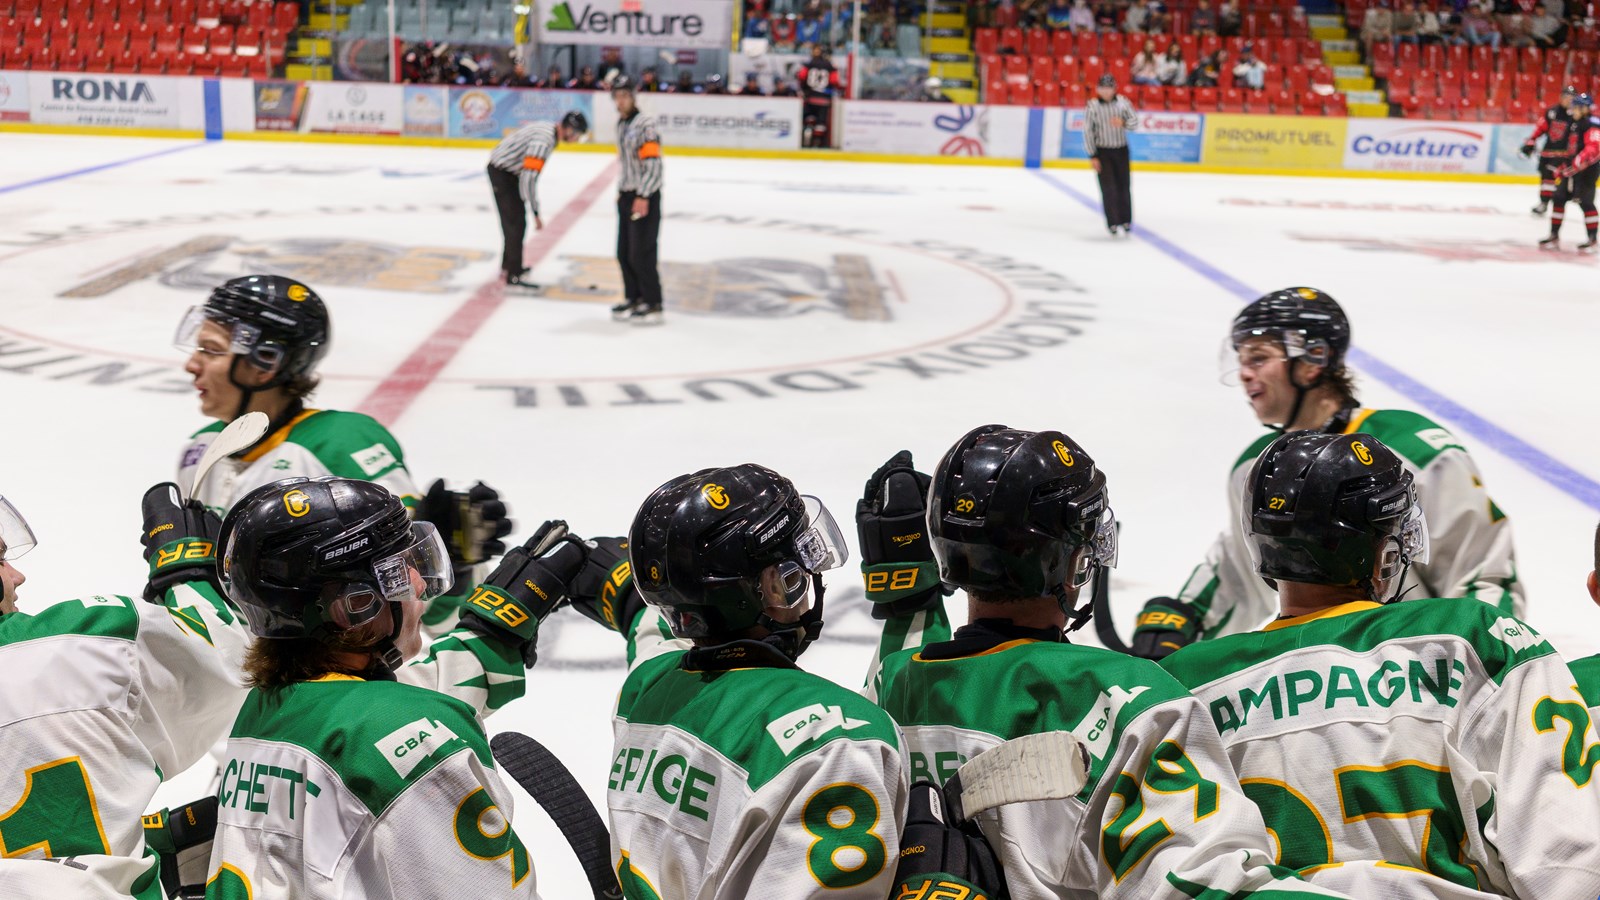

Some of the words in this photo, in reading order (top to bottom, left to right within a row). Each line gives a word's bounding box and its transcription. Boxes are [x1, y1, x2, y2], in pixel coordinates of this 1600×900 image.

[560, 2, 703, 36] Venture
[52, 78, 154, 102] RONA
[1215, 128, 1335, 146] PROMUTUEL
[1352, 135, 1479, 158] Couture
[956, 498, 975, 513] 29
[1269, 497, 1286, 510] 27
[760, 515, 790, 544] BAUER
[325, 537, 369, 561] BAUER
[650, 565, 659, 580] 8
[783, 713, 822, 740] CBA
[1087, 707, 1111, 742] CBA
[393, 729, 433, 758] CBA
[1101, 739, 1220, 886] 29
[453, 786, 530, 890] 9
[801, 781, 888, 890] 8
[900, 845, 926, 858] CONDO
